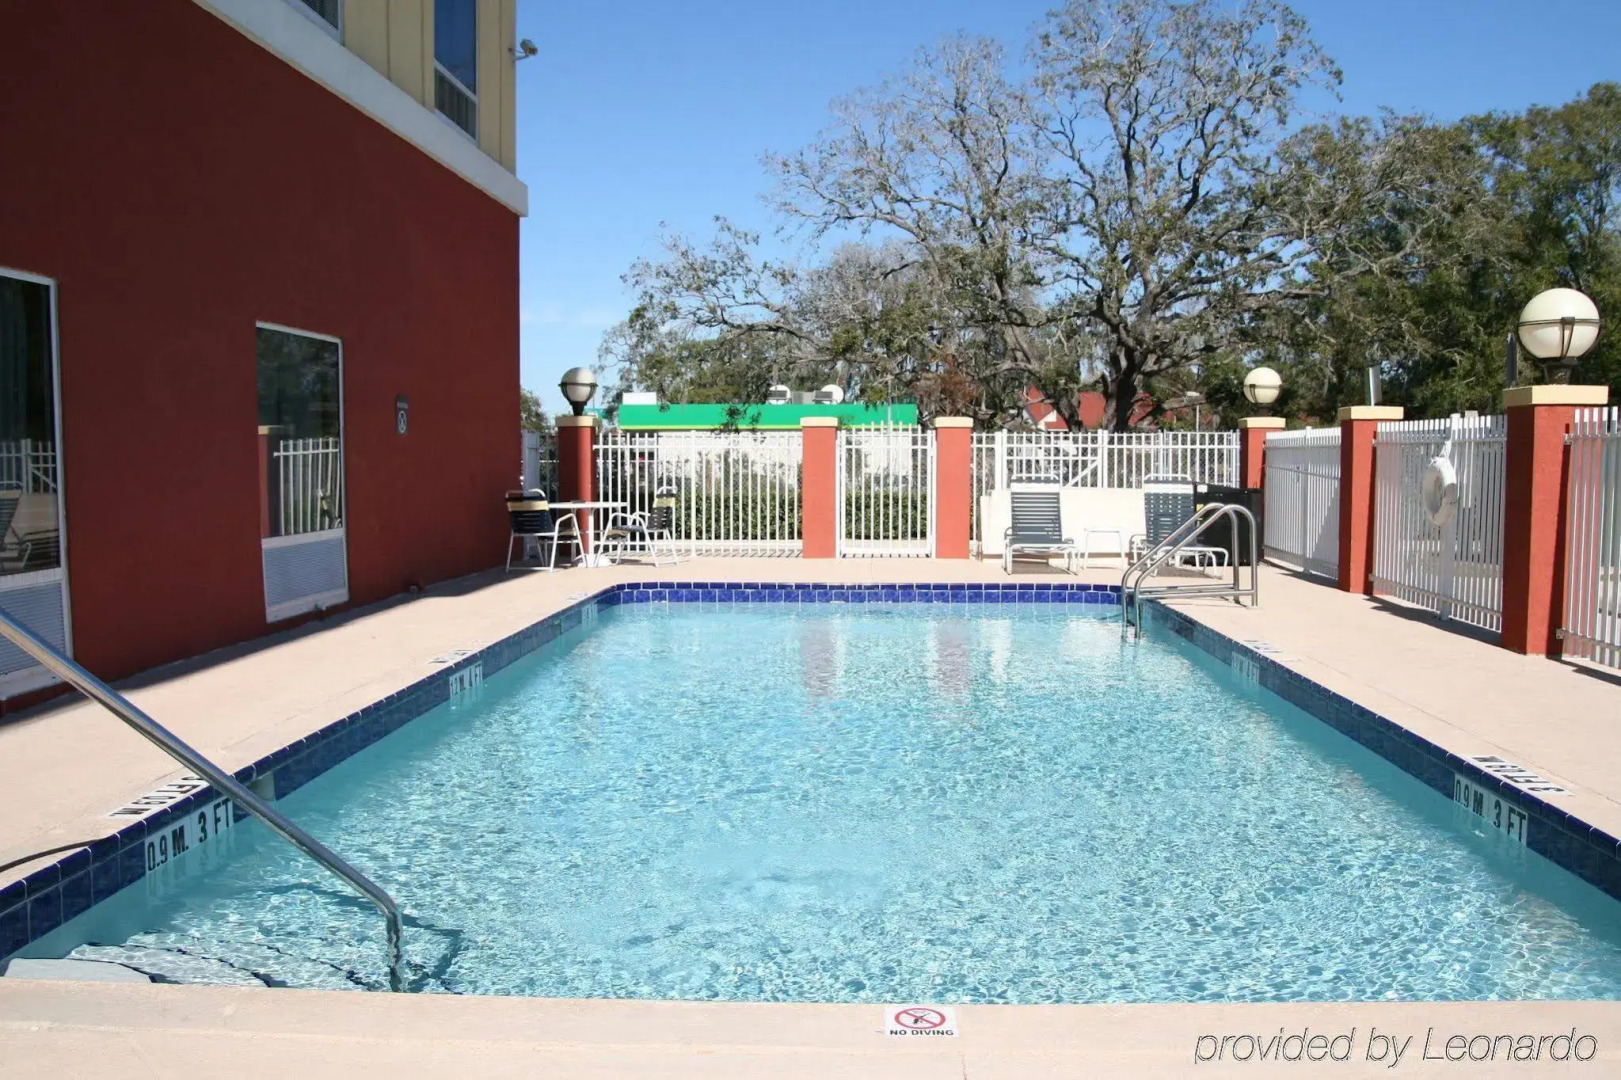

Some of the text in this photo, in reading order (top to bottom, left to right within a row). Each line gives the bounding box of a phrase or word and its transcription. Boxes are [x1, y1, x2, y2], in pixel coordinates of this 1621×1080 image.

[156, 784, 201, 795] FT
[1501, 774, 1550, 783] FT
[1493, 799, 1502, 829] 3
[1507, 806, 1527, 842] FT
[147, 834, 168, 872] 0.9
[198, 811, 207, 843] 3
[213, 797, 231, 835] FT
